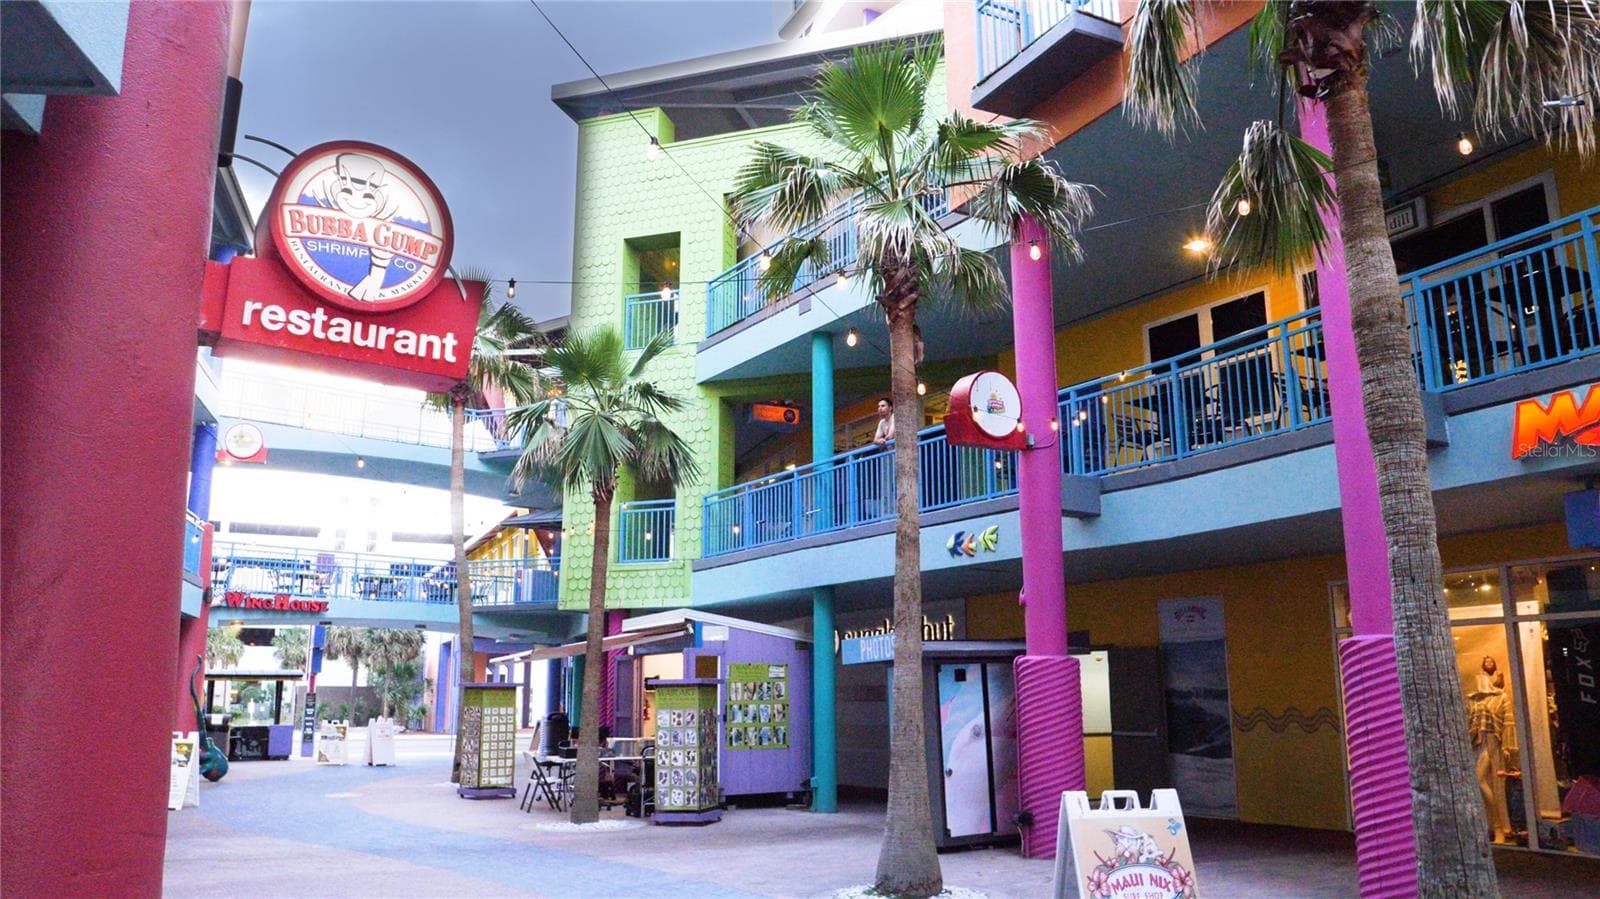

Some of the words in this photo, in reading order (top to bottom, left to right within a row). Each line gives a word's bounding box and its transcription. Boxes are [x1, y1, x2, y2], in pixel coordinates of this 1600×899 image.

[288, 209, 368, 243] BUBBA
[373, 223, 438, 260] GUMP
[306, 240, 370, 258] SHRIMP
[390, 269, 429, 296] MARKET
[241, 299, 458, 363] restaurant
[921, 614, 956, 641] hut
[1575, 655, 1598, 704] FOX
[1110, 873, 1144, 895] MAUI
[1149, 873, 1172, 892] NIX
